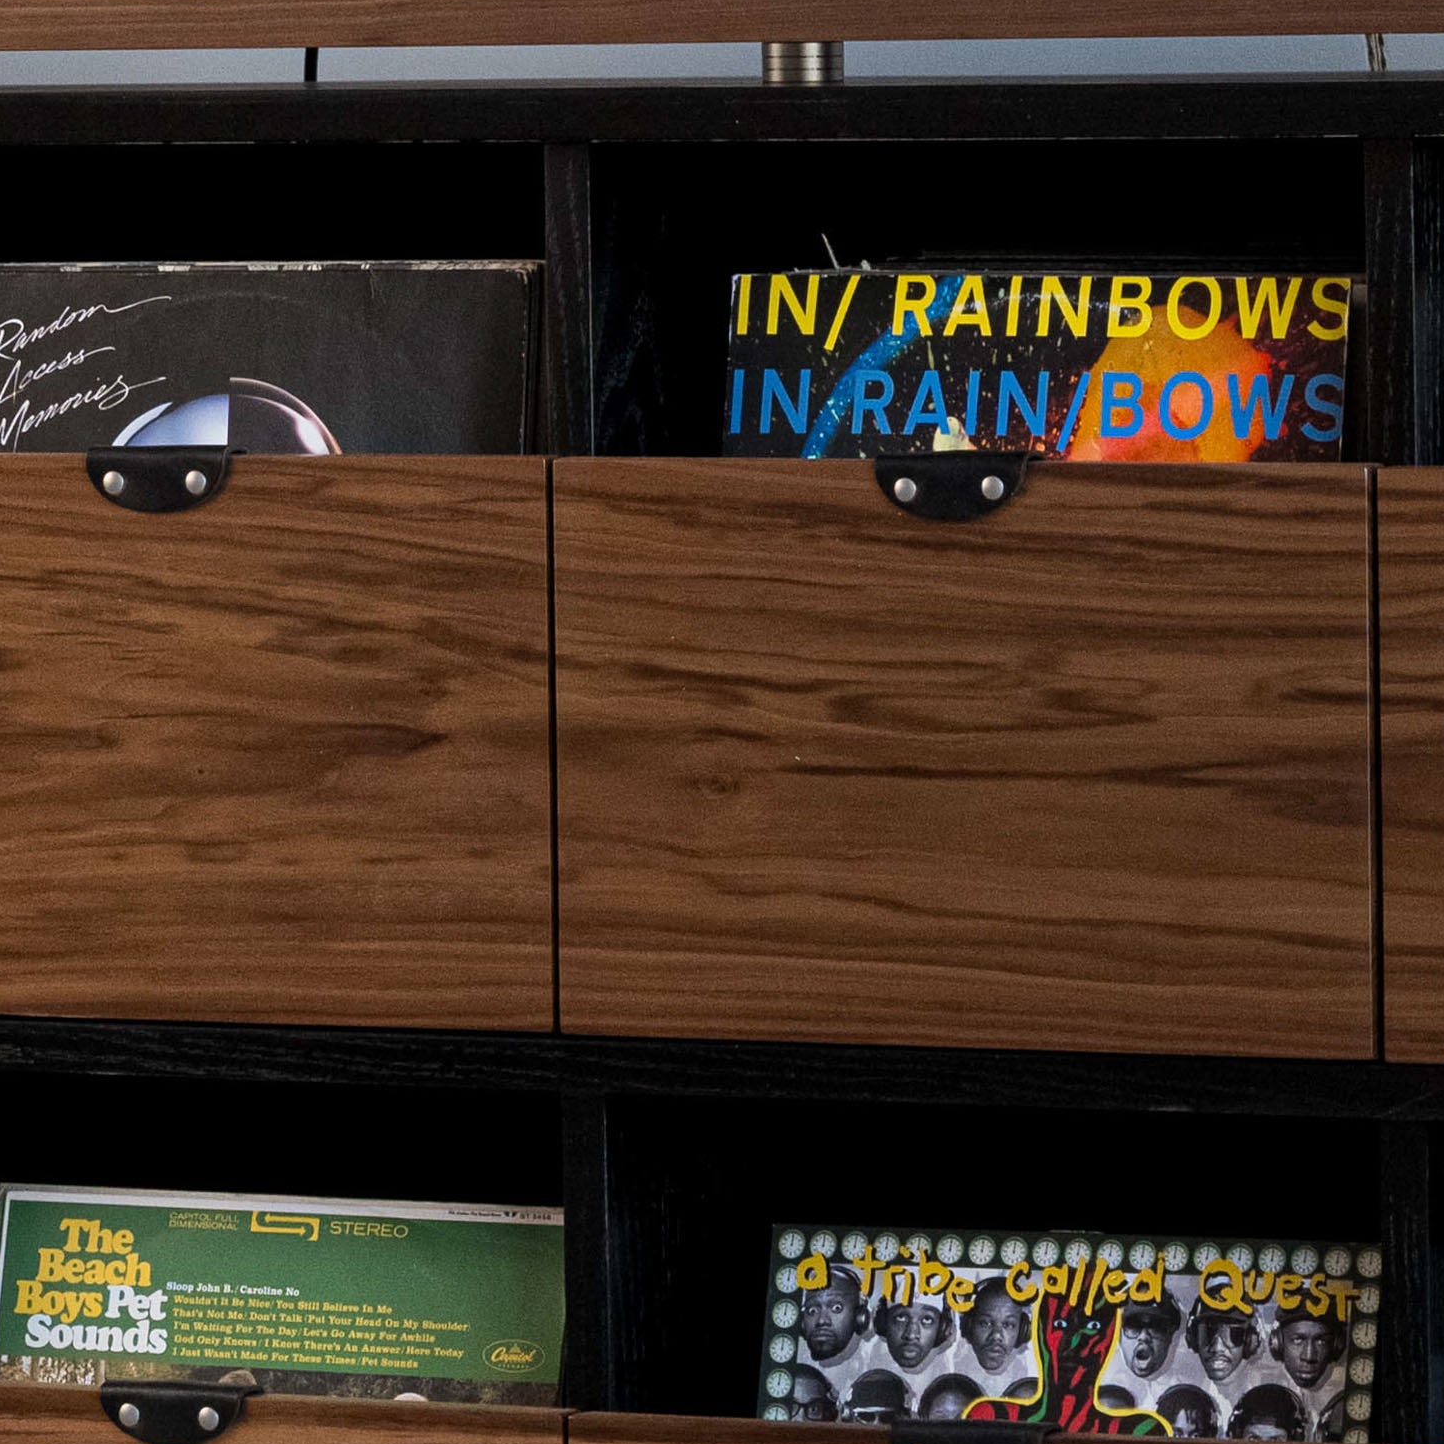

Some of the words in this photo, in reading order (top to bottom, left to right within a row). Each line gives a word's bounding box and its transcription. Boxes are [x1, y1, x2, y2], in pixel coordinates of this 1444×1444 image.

[891, 275, 1351, 341] RAINBOWS
[730, 368, 812, 435] IN
[59, 1218, 135, 1255] The
[169, 1220, 239, 1231] DIMENSIONAL
[329, 1221, 409, 1238] STEREO
[35, 1247, 152, 1287] Beach
[166, 1282, 194, 1293] Sloop
[197, 1283, 220, 1293] John
[240, 1285, 282, 1296] Caroline
[286, 1287, 300, 1296] No
[796, 1251, 829, 1290] a
[853, 1244, 976, 1313] tribe
[1005, 1251, 1165, 1316] called
[13, 1280, 104, 1324] Boys
[104, 1285, 169, 1321] Pet
[174, 1295, 217, 1305] Wouldn't
[221, 1297, 228, 1306] It
[232, 1297, 243, 1307] Be
[276, 1300, 294, 1309] You
[298, 1301, 320, 1311] Still
[323, 1302, 359, 1312] Believe
[363, 1304, 373, 1313] In
[377, 1305, 392, 1314] Me
[172, 1308, 203, 1318] That's
[207, 1310, 224, 1319] Not
[250, 1312, 276, 1321] Don't
[280, 1313, 302, 1323] Talk
[329, 1316, 352, 1326] Your
[355, 1316, 381, 1327] Head
[385, 1318, 399, 1328] On
[403, 1319, 418, 1330] My
[25, 1313, 168, 1354] Sounds
[173, 1321, 190, 1330] I'm
[194, 1322, 233, 1334] Waiting
[236, 1324, 253, 1333] For
[256, 1325, 275, 1335] The
[331, 1329, 345, 1338] Go
[348, 1330, 375, 1340] Away
[379, 1332, 397, 1341] For
[400, 1332, 436, 1343] Awhile
[174, 1334, 193, 1344] God
[197, 1336, 220, 1345] Only
[272, 1340, 301, 1349] Know
[303, 1340, 340, 1351] There's
[344, 1343, 358, 1352] An
[434, 1347, 464, 1359] Today
[180, 1348, 200, 1357] Just
[204, 1348, 237, 1359] Wasn't
[241, 1350, 268, 1360] Made
[272, 1352, 288, 1361] For
[292, 1352, 322, 1363] These
[381, 1358, 418, 1368] Sounds
